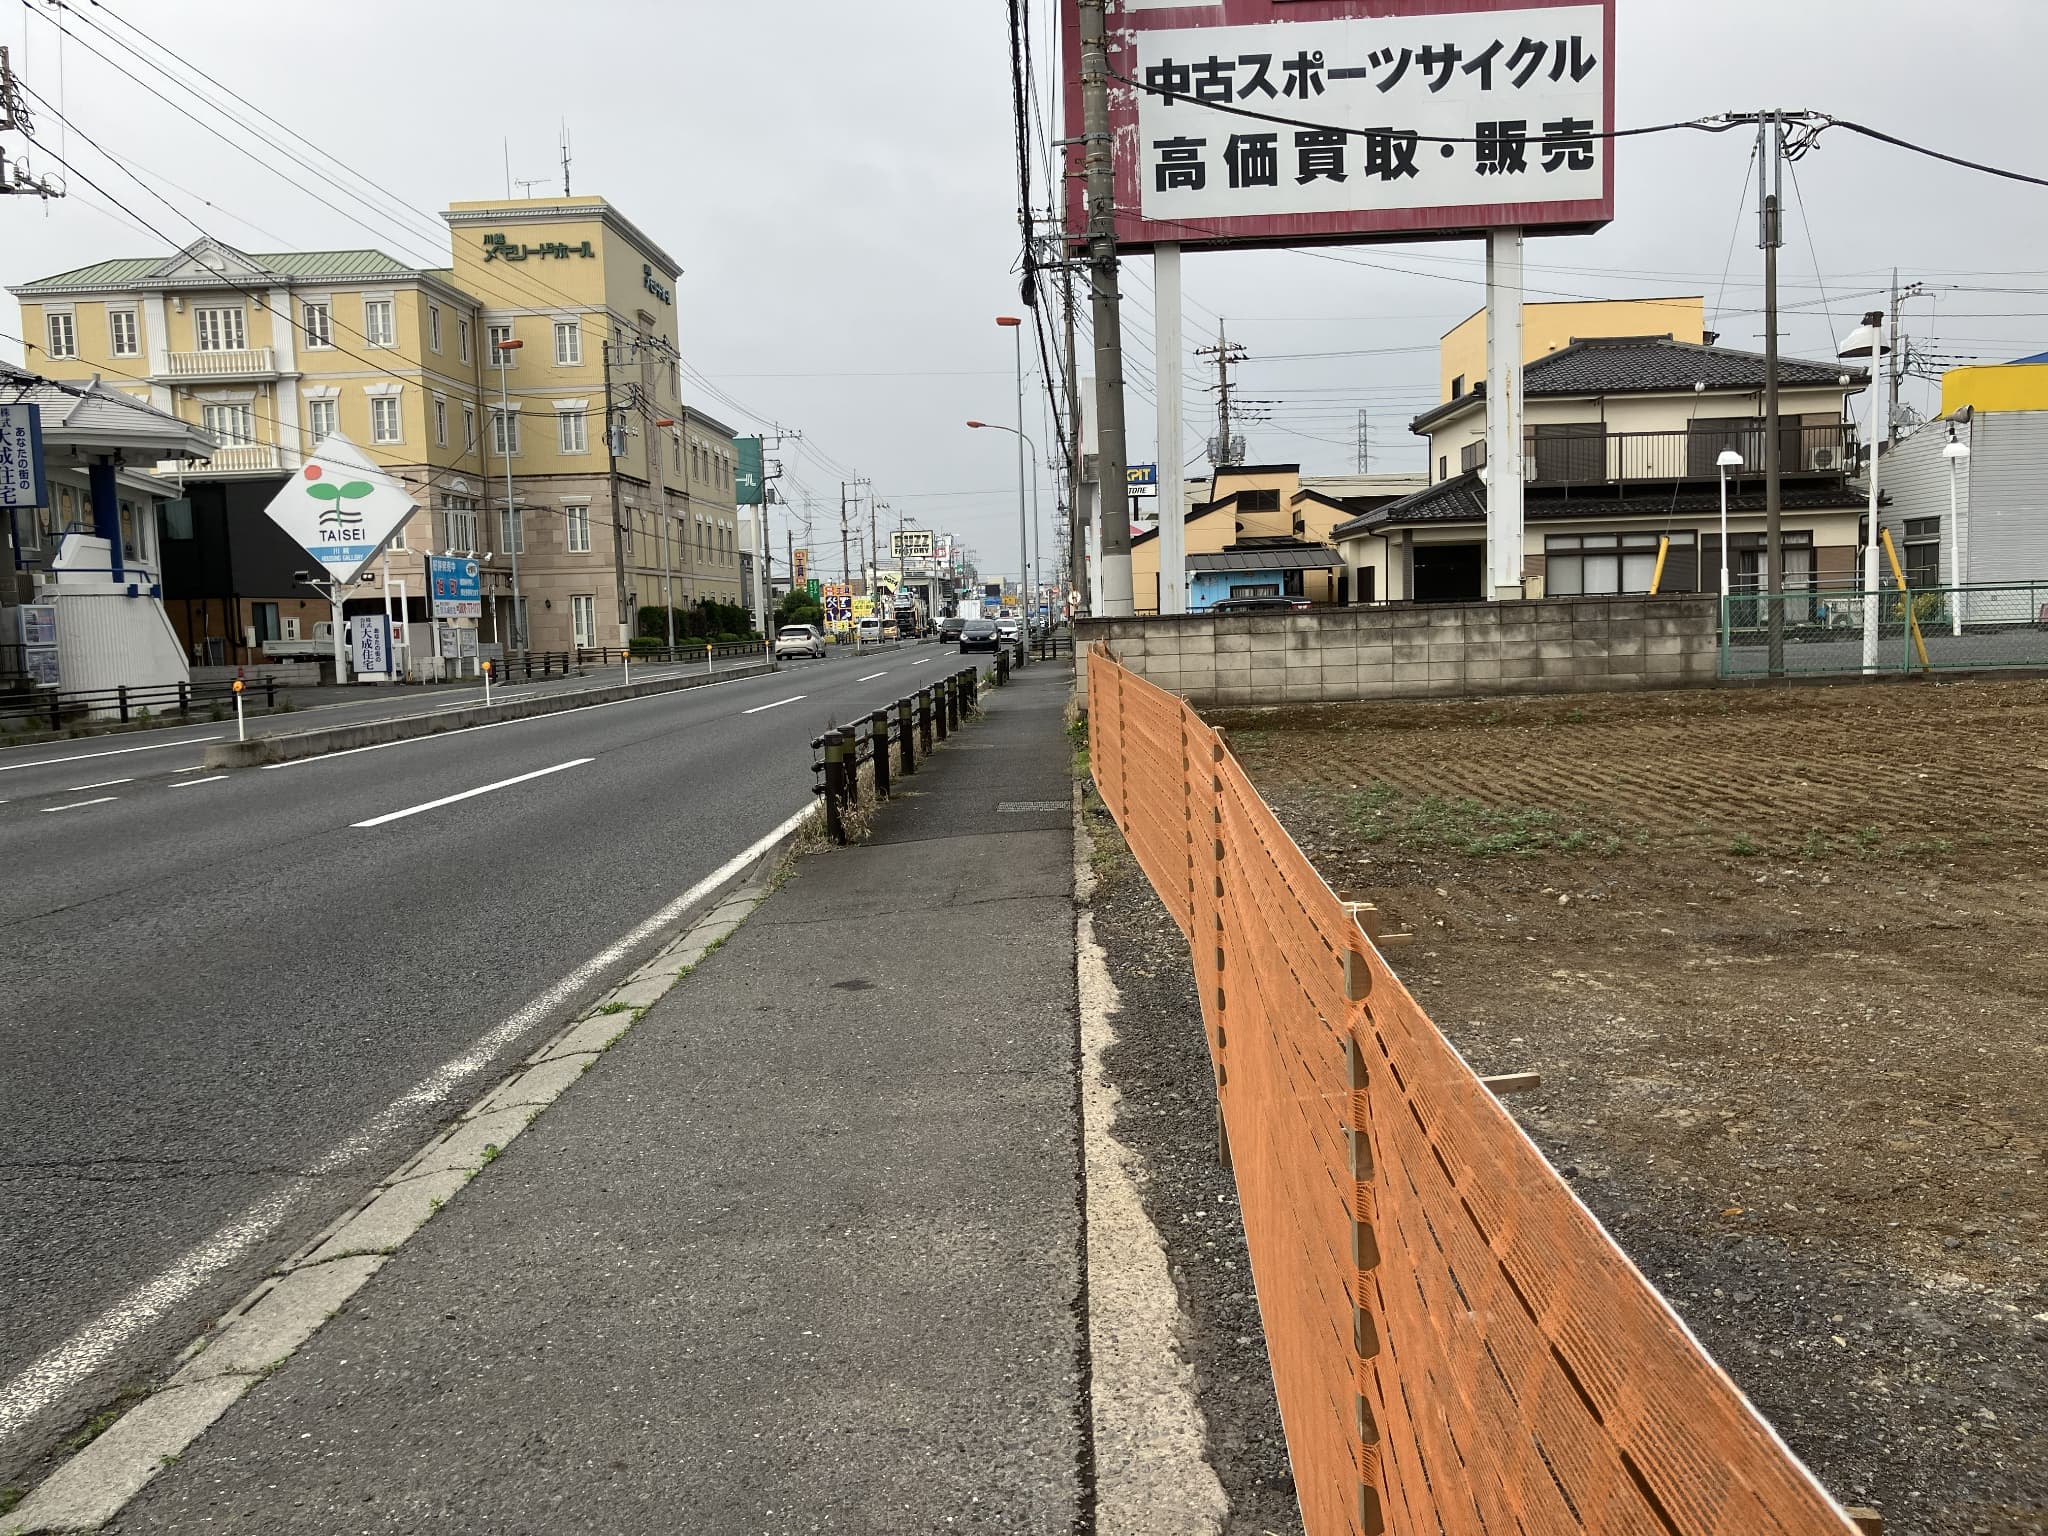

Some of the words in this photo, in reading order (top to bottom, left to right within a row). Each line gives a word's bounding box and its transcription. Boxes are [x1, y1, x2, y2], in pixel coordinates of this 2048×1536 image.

[1146, 36, 1597, 106] 中古スポーツサイクル
[1153, 117, 1594, 192] 高価買取・販売
[16, 427, 30, 489] あなたの街の
[319, 528, 366, 542] TAISEI
[361, 628, 374, 670] 大成住宅
